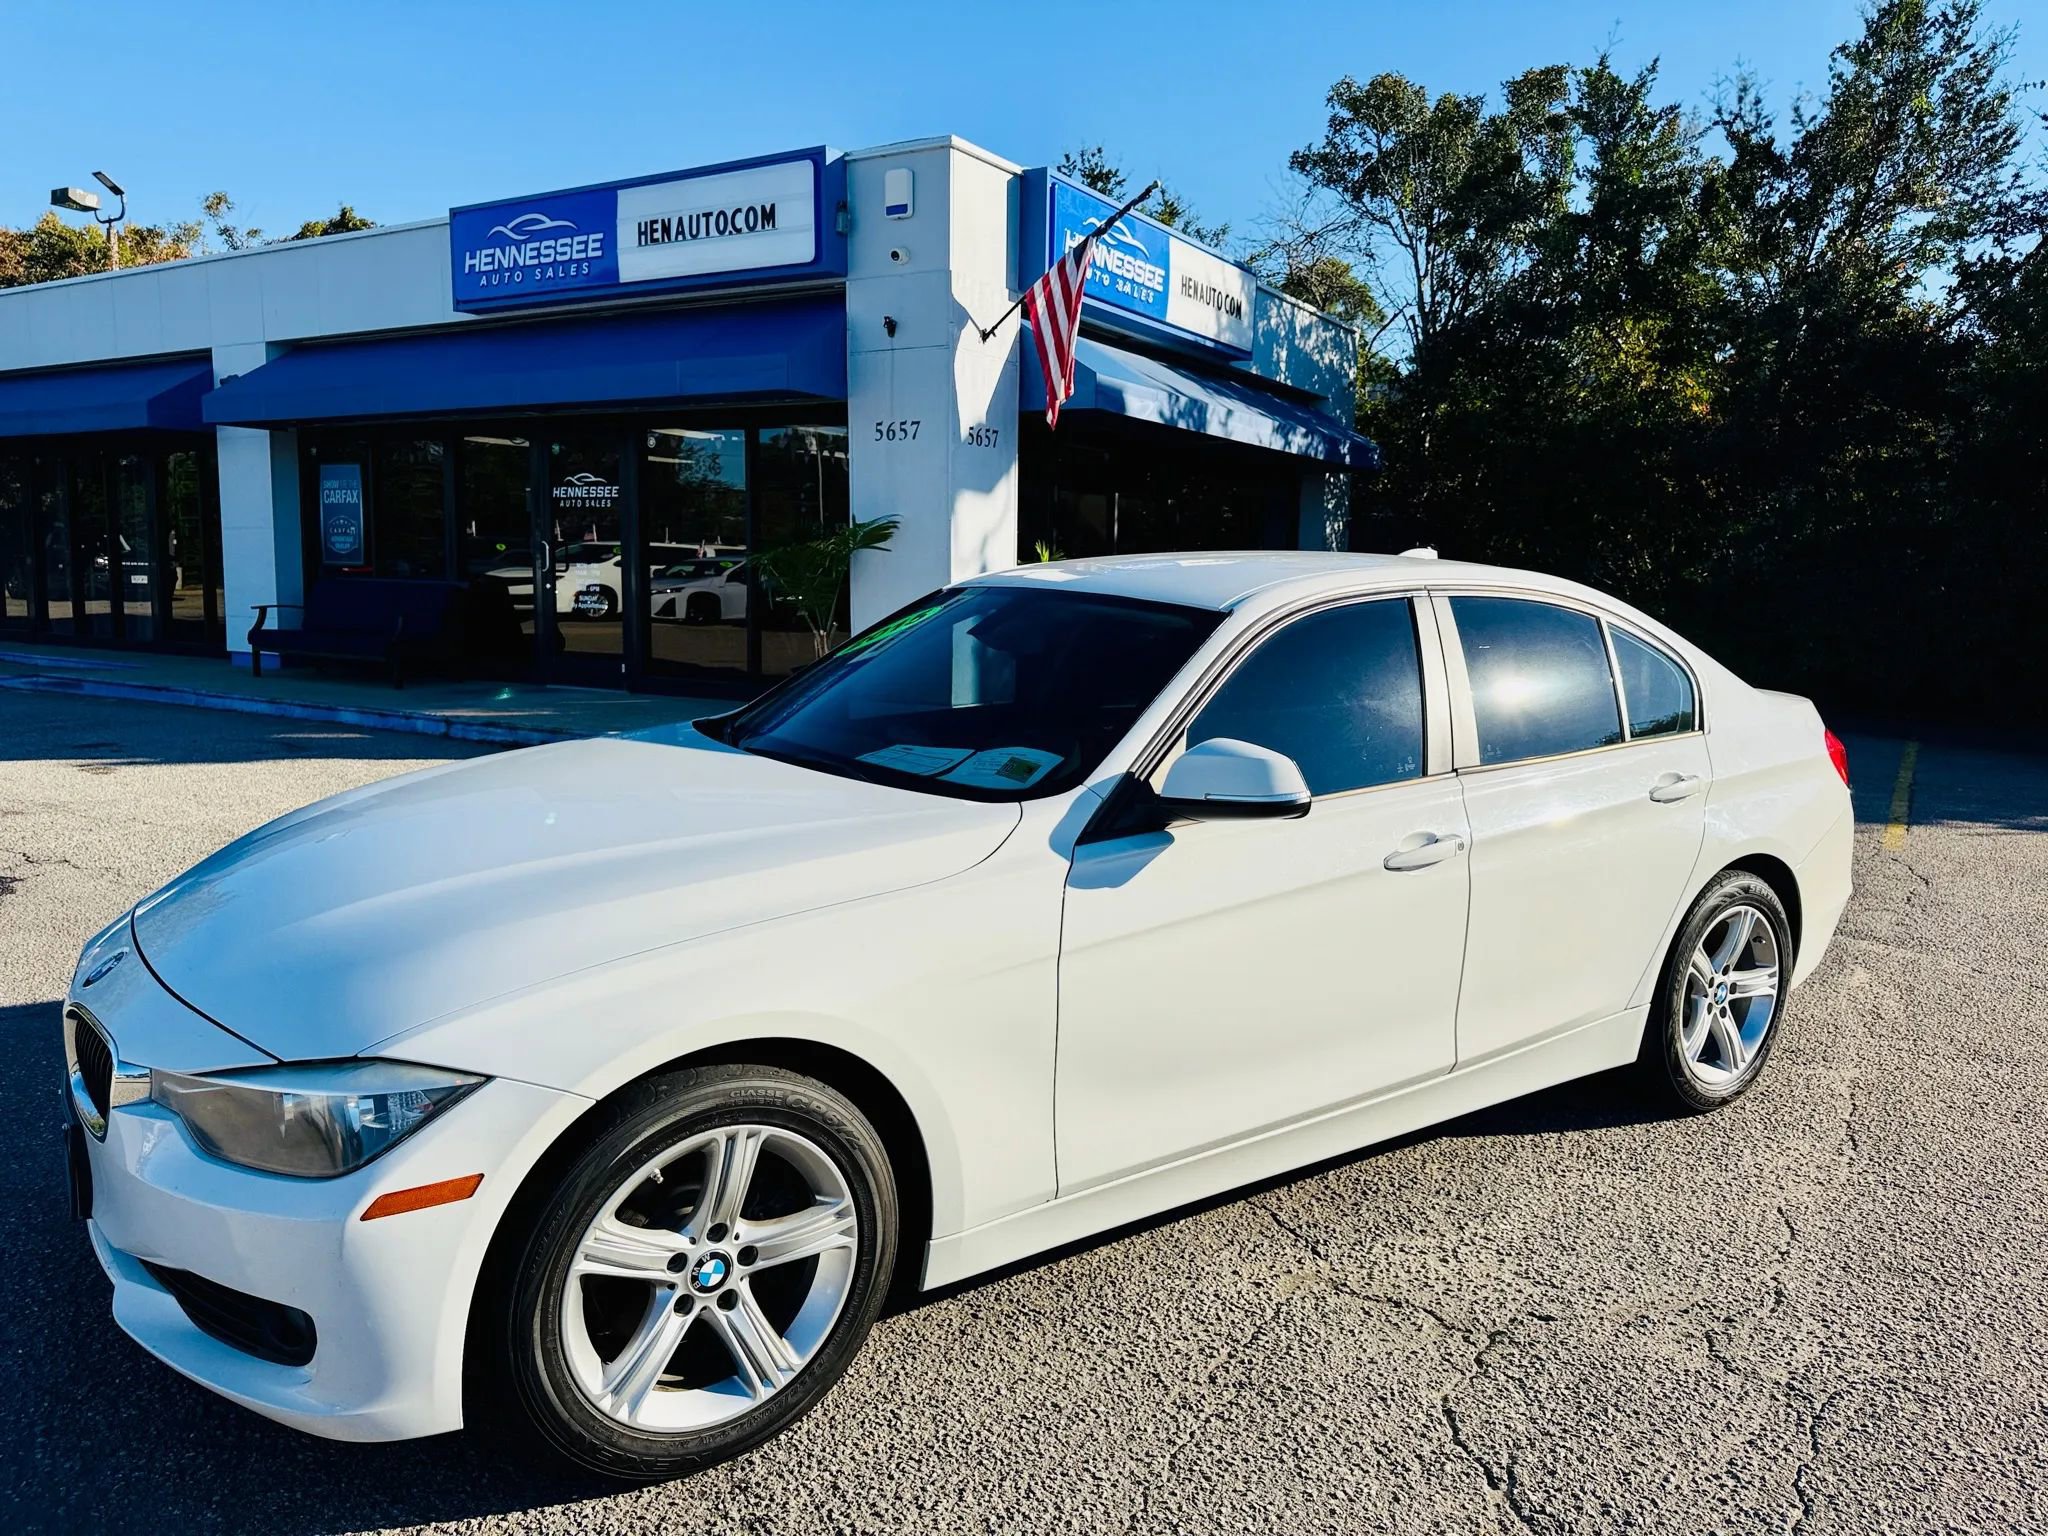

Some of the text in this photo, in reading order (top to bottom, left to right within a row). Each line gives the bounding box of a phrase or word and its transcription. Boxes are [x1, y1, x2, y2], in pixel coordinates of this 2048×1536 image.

[637, 202, 777, 247] HENAUTO.COM
[464, 232, 604, 274] HENNESSEE
[479, 262, 591, 288] AUTO SALES
[1115, 278, 1155, 304] SALES
[874, 420, 921, 442] 5657
[967, 426, 999, 448] 5657
[323, 489, 359, 504] CARFAX
[553, 486, 620, 498] HENNESSEE
[560, 499, 612, 508] AUTO SALES
[729, 1087, 784, 1098] CLASSE
[692, 1253, 711, 1289] BMW
